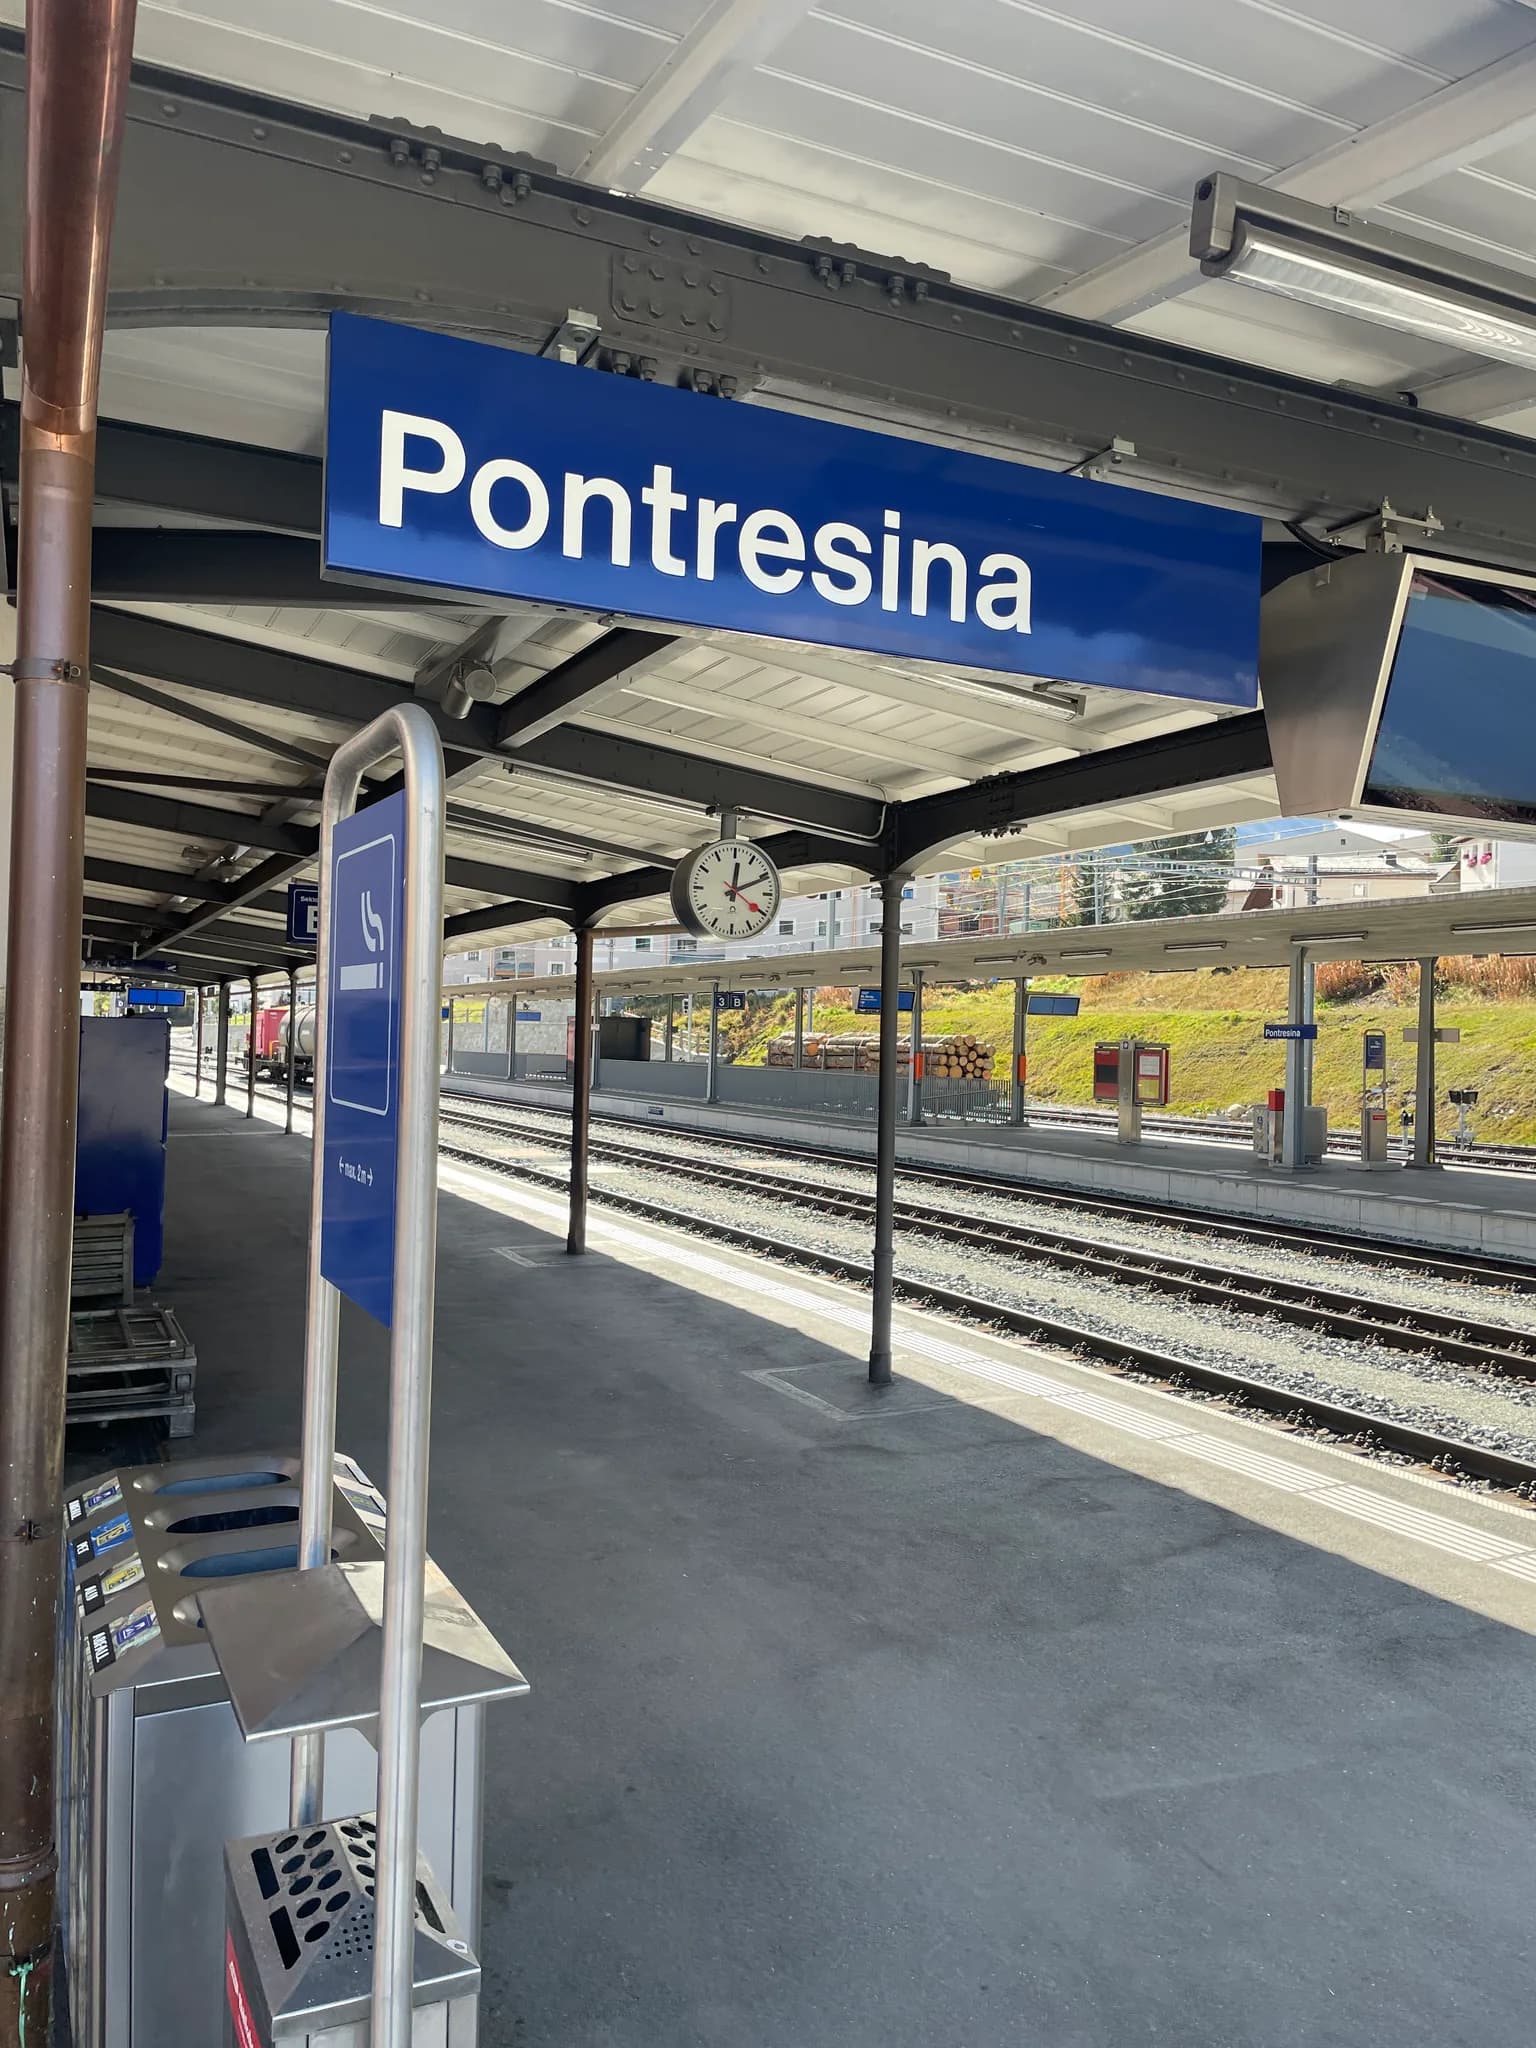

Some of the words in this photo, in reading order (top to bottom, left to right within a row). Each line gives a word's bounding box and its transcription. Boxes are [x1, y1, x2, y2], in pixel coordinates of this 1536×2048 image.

[378, 409, 1033, 635] Pontresina
[719, 997, 725, 1007] 3
[734, 998, 741, 1007] B
[1265, 1029, 1301, 1037] Pontresina
[84, 1584, 99, 1602] ALU
